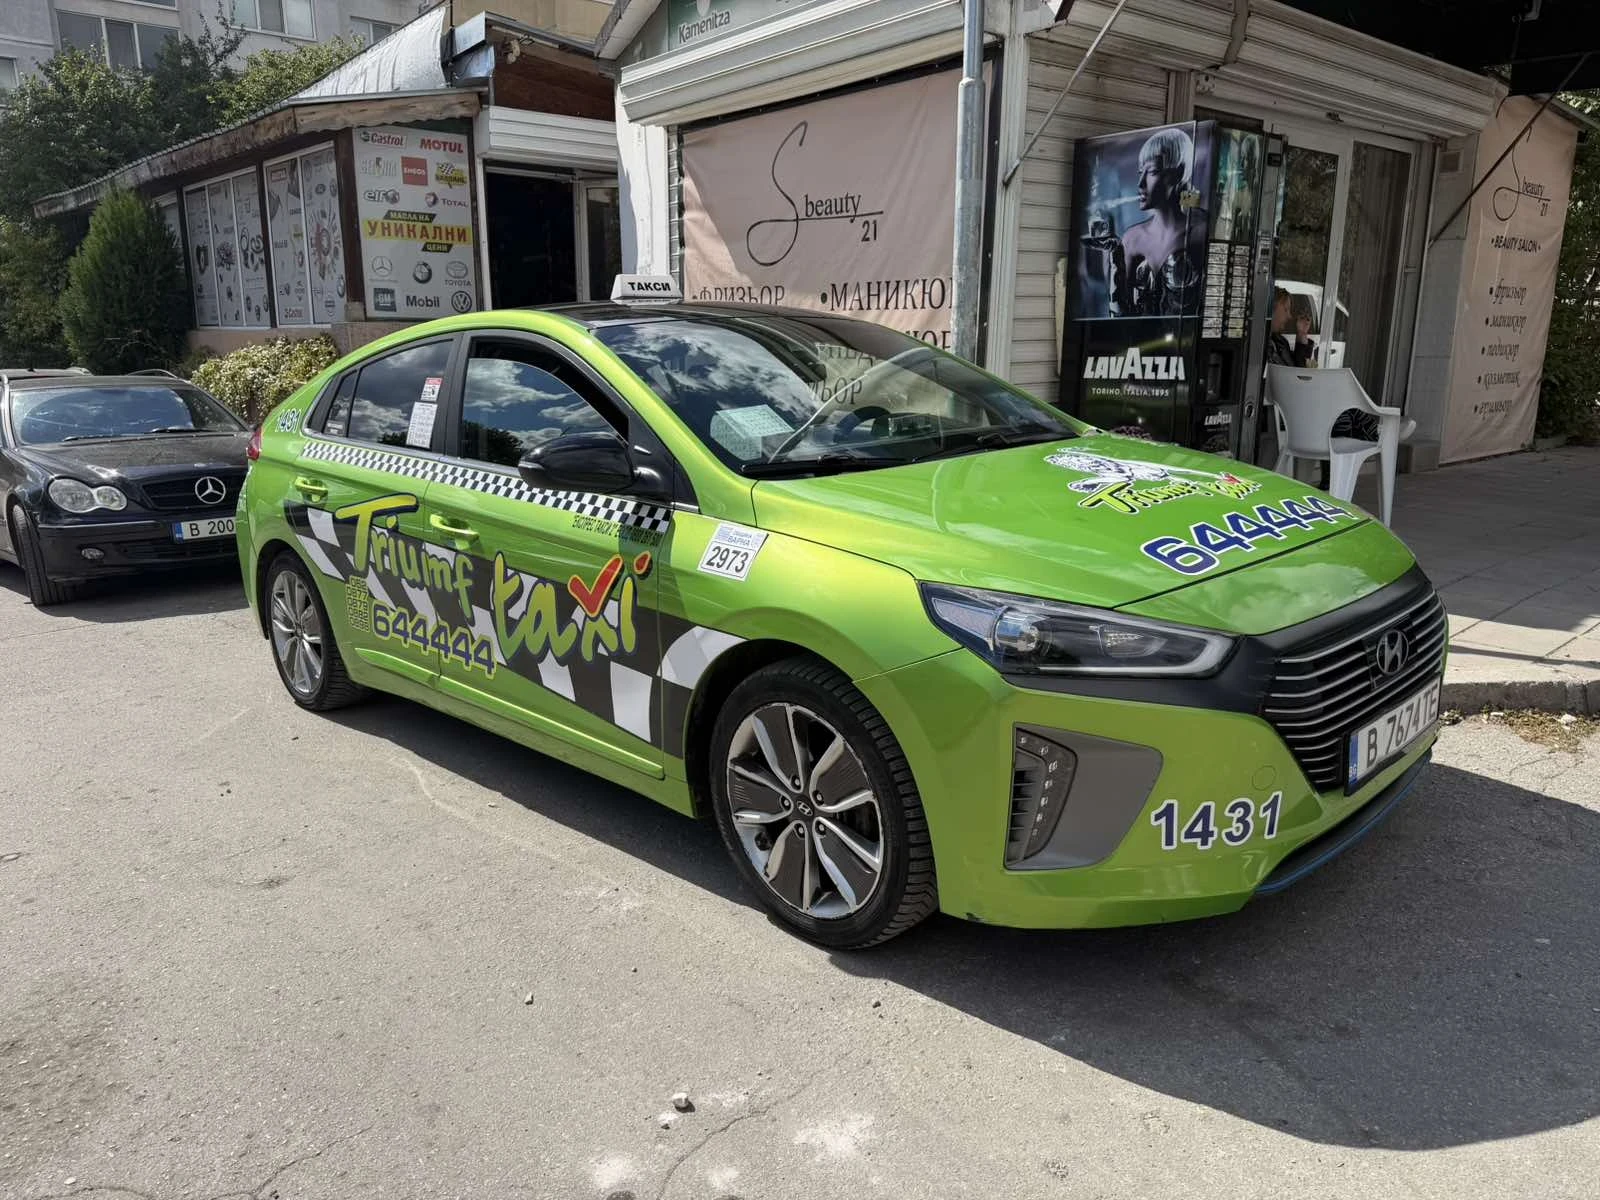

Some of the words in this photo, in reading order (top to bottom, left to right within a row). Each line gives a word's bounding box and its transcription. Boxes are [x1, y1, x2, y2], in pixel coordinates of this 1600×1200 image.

[678, 10, 731, 44] Kamenitza
[370, 132, 404, 146] Castrol
[420, 138, 464, 153] MOTUL
[441, 198, 469, 208] TOTAL
[1522, 176, 1545, 203] beauty
[804, 192, 862, 223] beauty
[367, 220, 468, 242] УНИКАЛНИ
[861, 221, 878, 242] 21
[1494, 235, 1518, 250] BEAUTY
[1518, 238, 1538, 253] SALON
[444, 279, 472, 287] TOYOTA
[627, 282, 671, 292] ТАКСИ
[830, 277, 953, 311] МАНИКЮ
[405, 295, 440, 308] Mobil
[1083, 347, 1185, 380] LAVAZZA
[1151, 388, 1169, 397] 1895
[1140, 496, 1360, 576] 644444
[334, 492, 475, 622] Triumf
[706, 545, 749, 573] 2973
[373, 602, 498, 680] 644444
[1366, 727, 1378, 769] B
[1385, 696, 1421, 755] 7674
[1150, 791, 1283, 850] 1431
